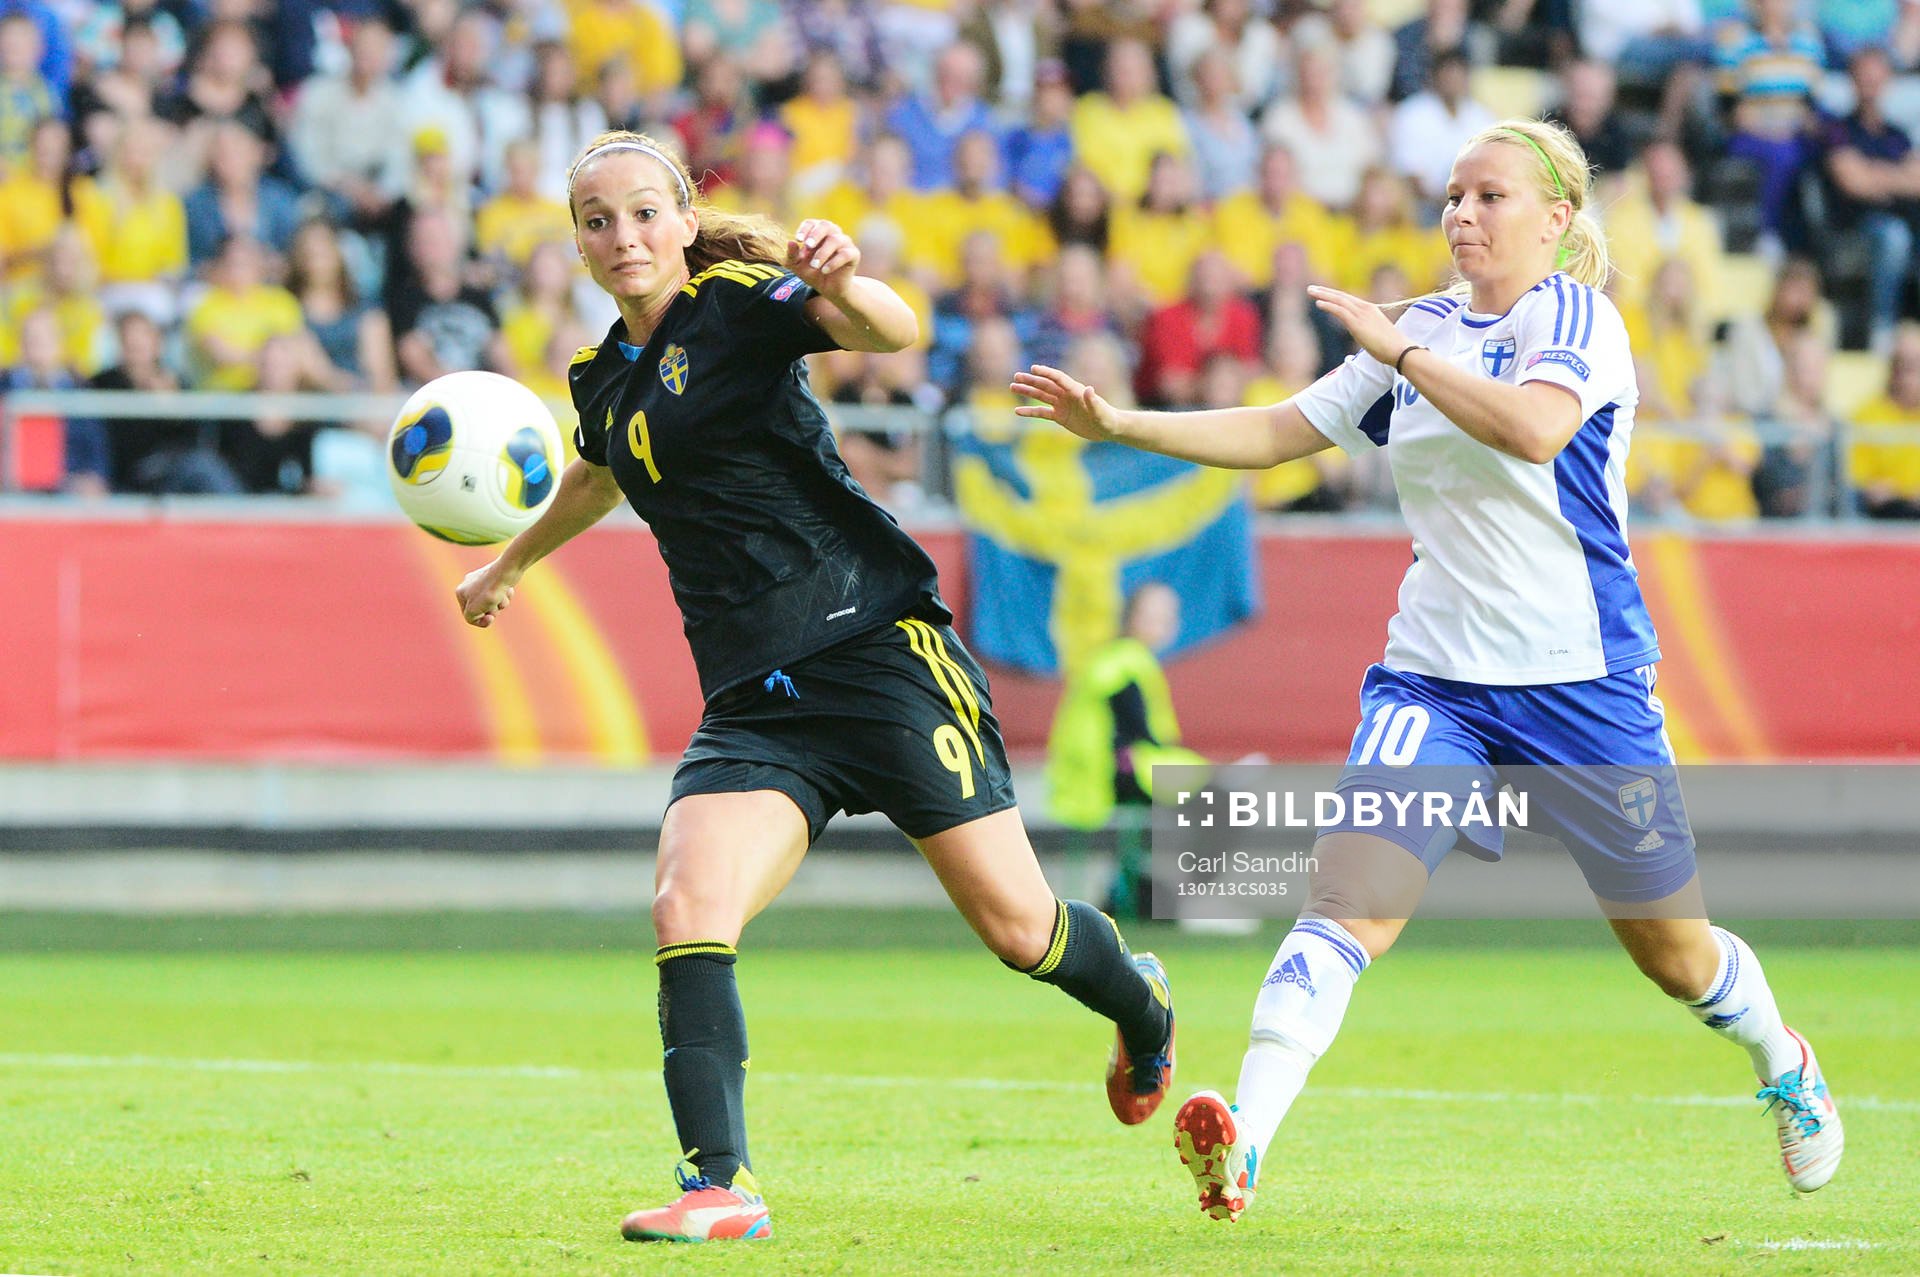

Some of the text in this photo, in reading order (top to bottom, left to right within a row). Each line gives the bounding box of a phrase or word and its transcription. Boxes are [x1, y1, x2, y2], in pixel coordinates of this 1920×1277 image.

[1542, 350, 1590, 378] RESPECT
[627, 410, 662, 484] 9
[933, 724, 976, 800] 9
[1357, 703, 1430, 768] 10
[1634, 838, 1666, 853] adidas
